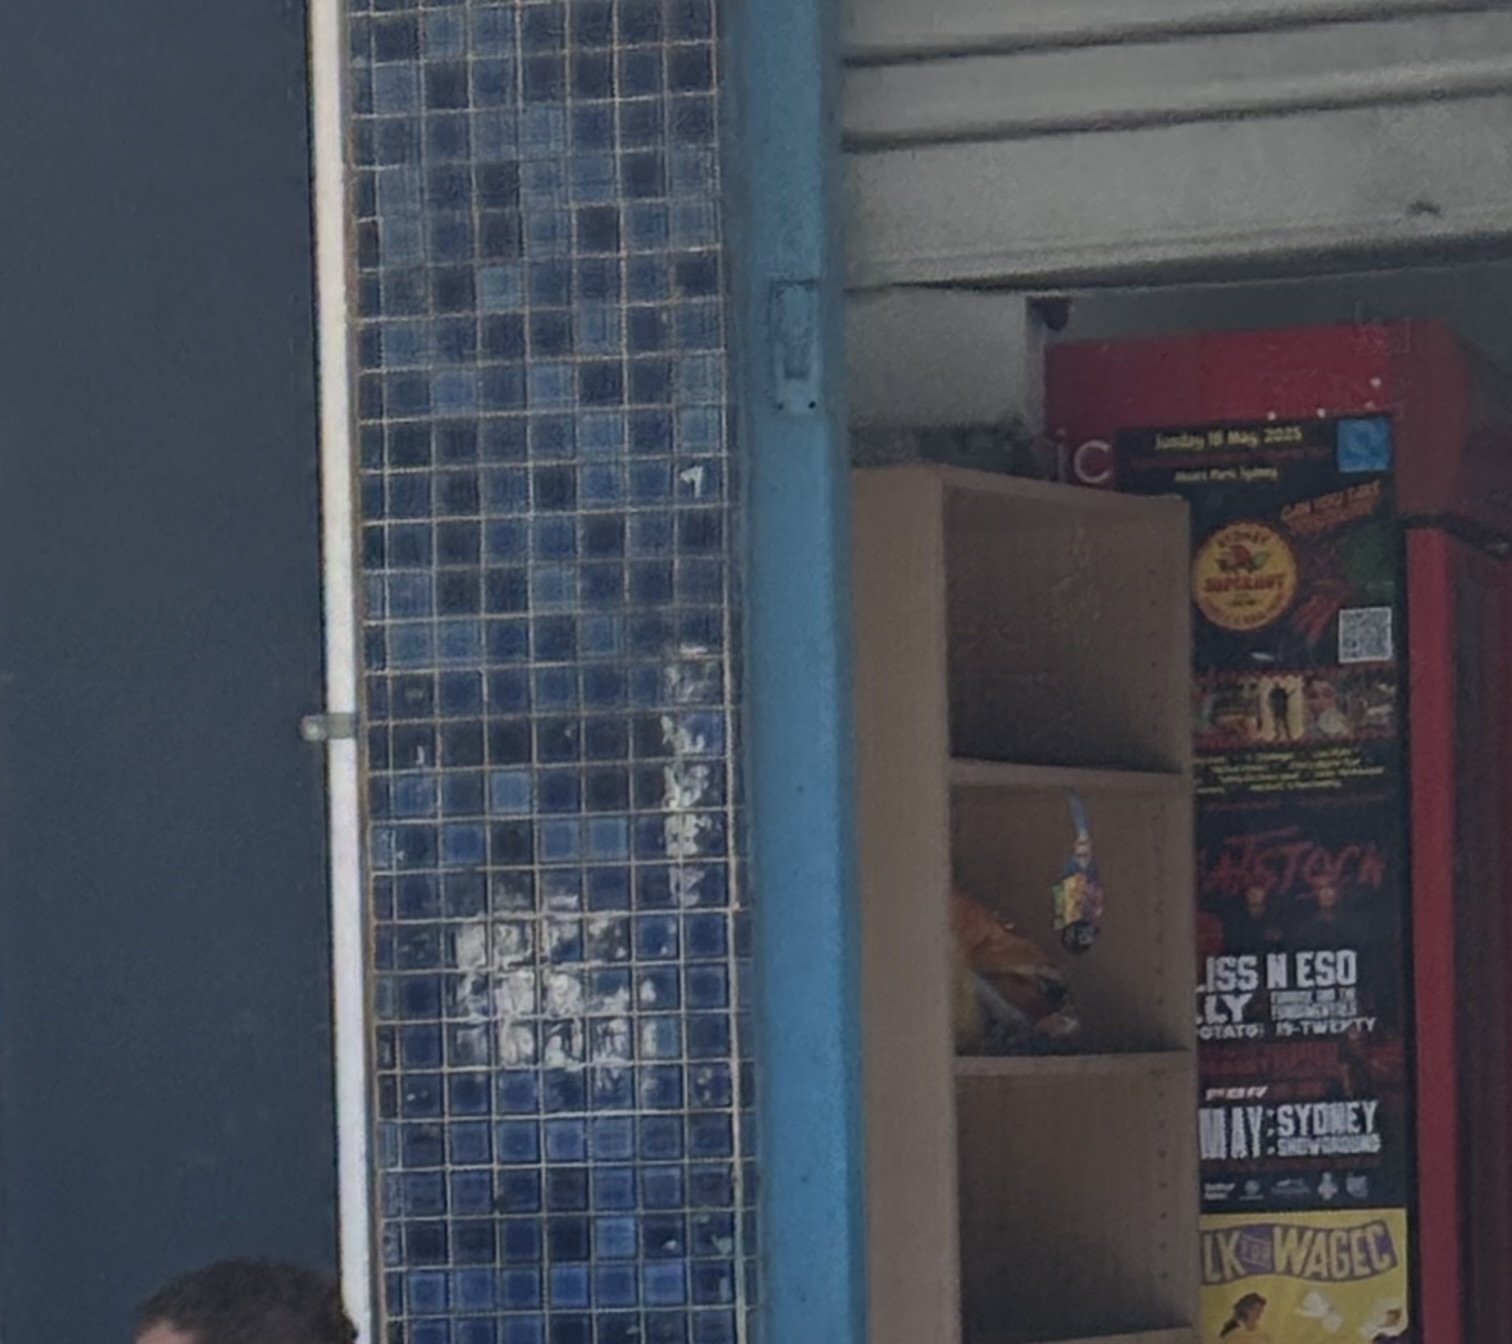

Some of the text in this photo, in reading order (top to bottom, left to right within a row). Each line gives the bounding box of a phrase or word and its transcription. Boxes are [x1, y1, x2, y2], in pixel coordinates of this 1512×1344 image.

[1264, 425, 1303, 444] 2025
[1195, 950, 1358, 993] ISS N ESO
[1195, 993, 1253, 1025] LY
[1198, 1099, 1378, 1161] MAY SYDNEY
[1272, 1224, 1392, 1280] WAGEC
